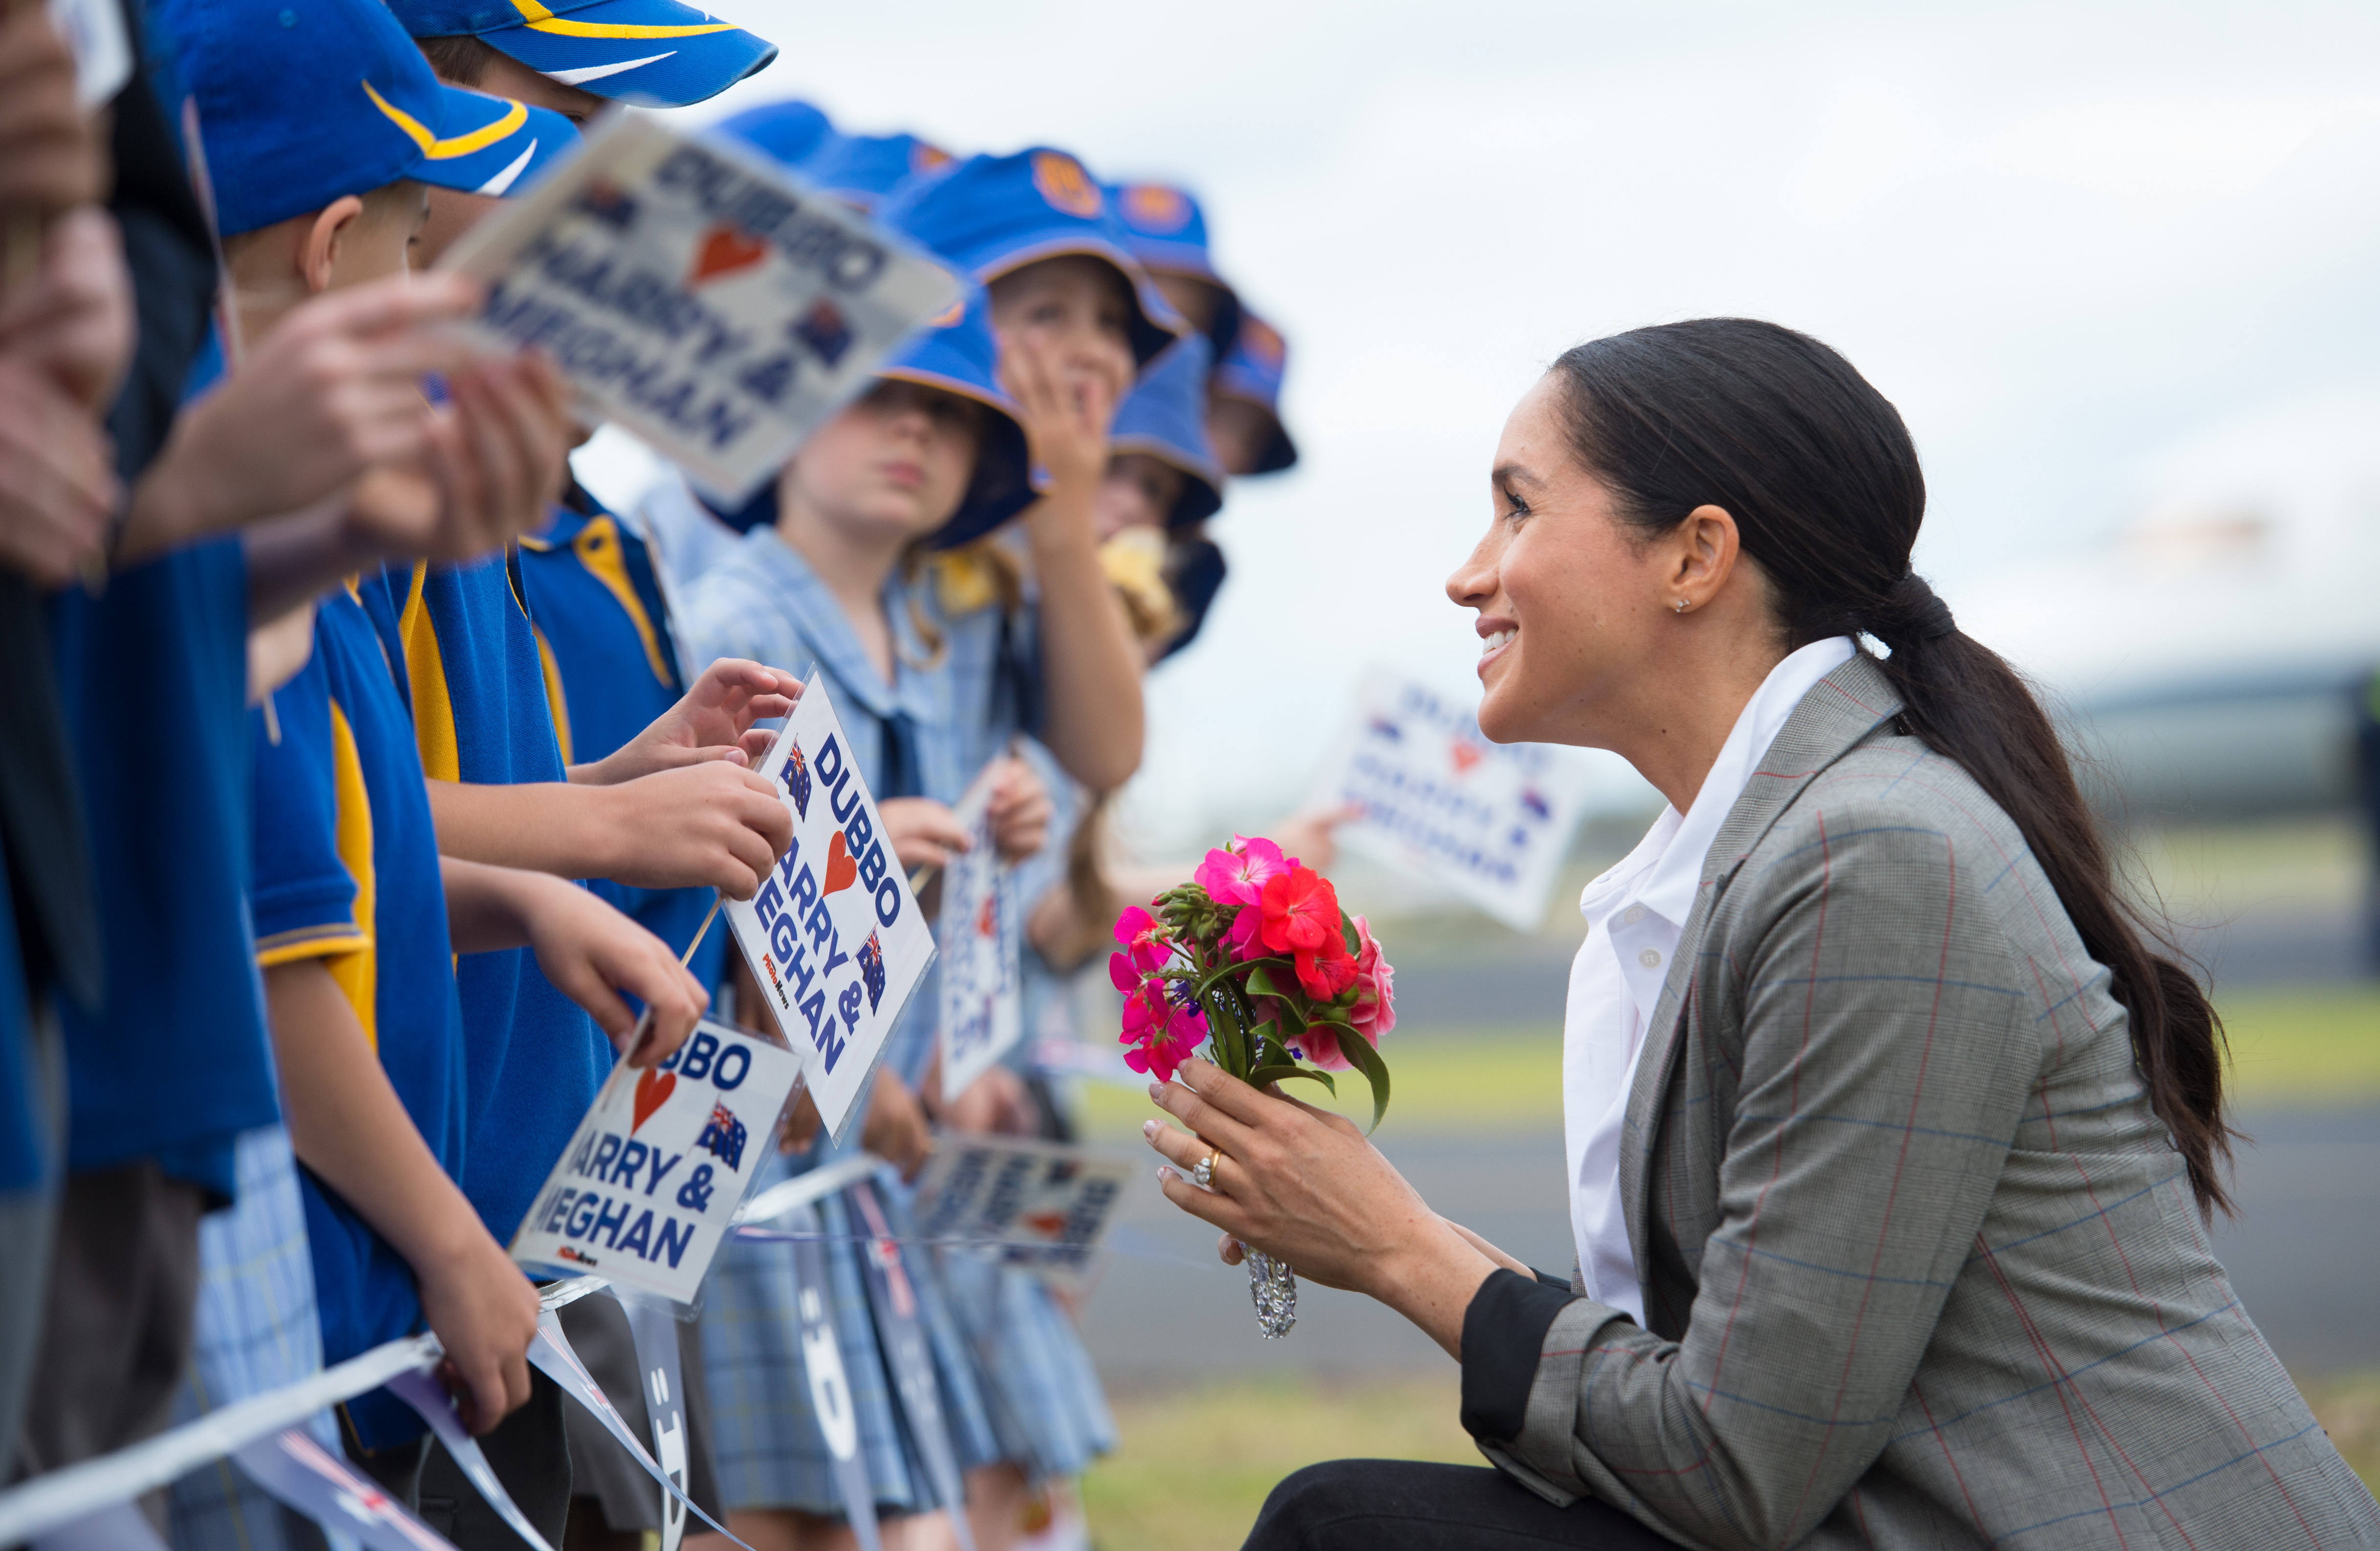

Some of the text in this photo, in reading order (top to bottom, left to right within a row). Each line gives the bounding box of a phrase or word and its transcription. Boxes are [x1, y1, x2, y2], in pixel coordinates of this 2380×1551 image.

[814, 732, 900, 928] DUBBO
[779, 836, 862, 1036] ARRY &
[565, 1130, 714, 1213] ARRY &
